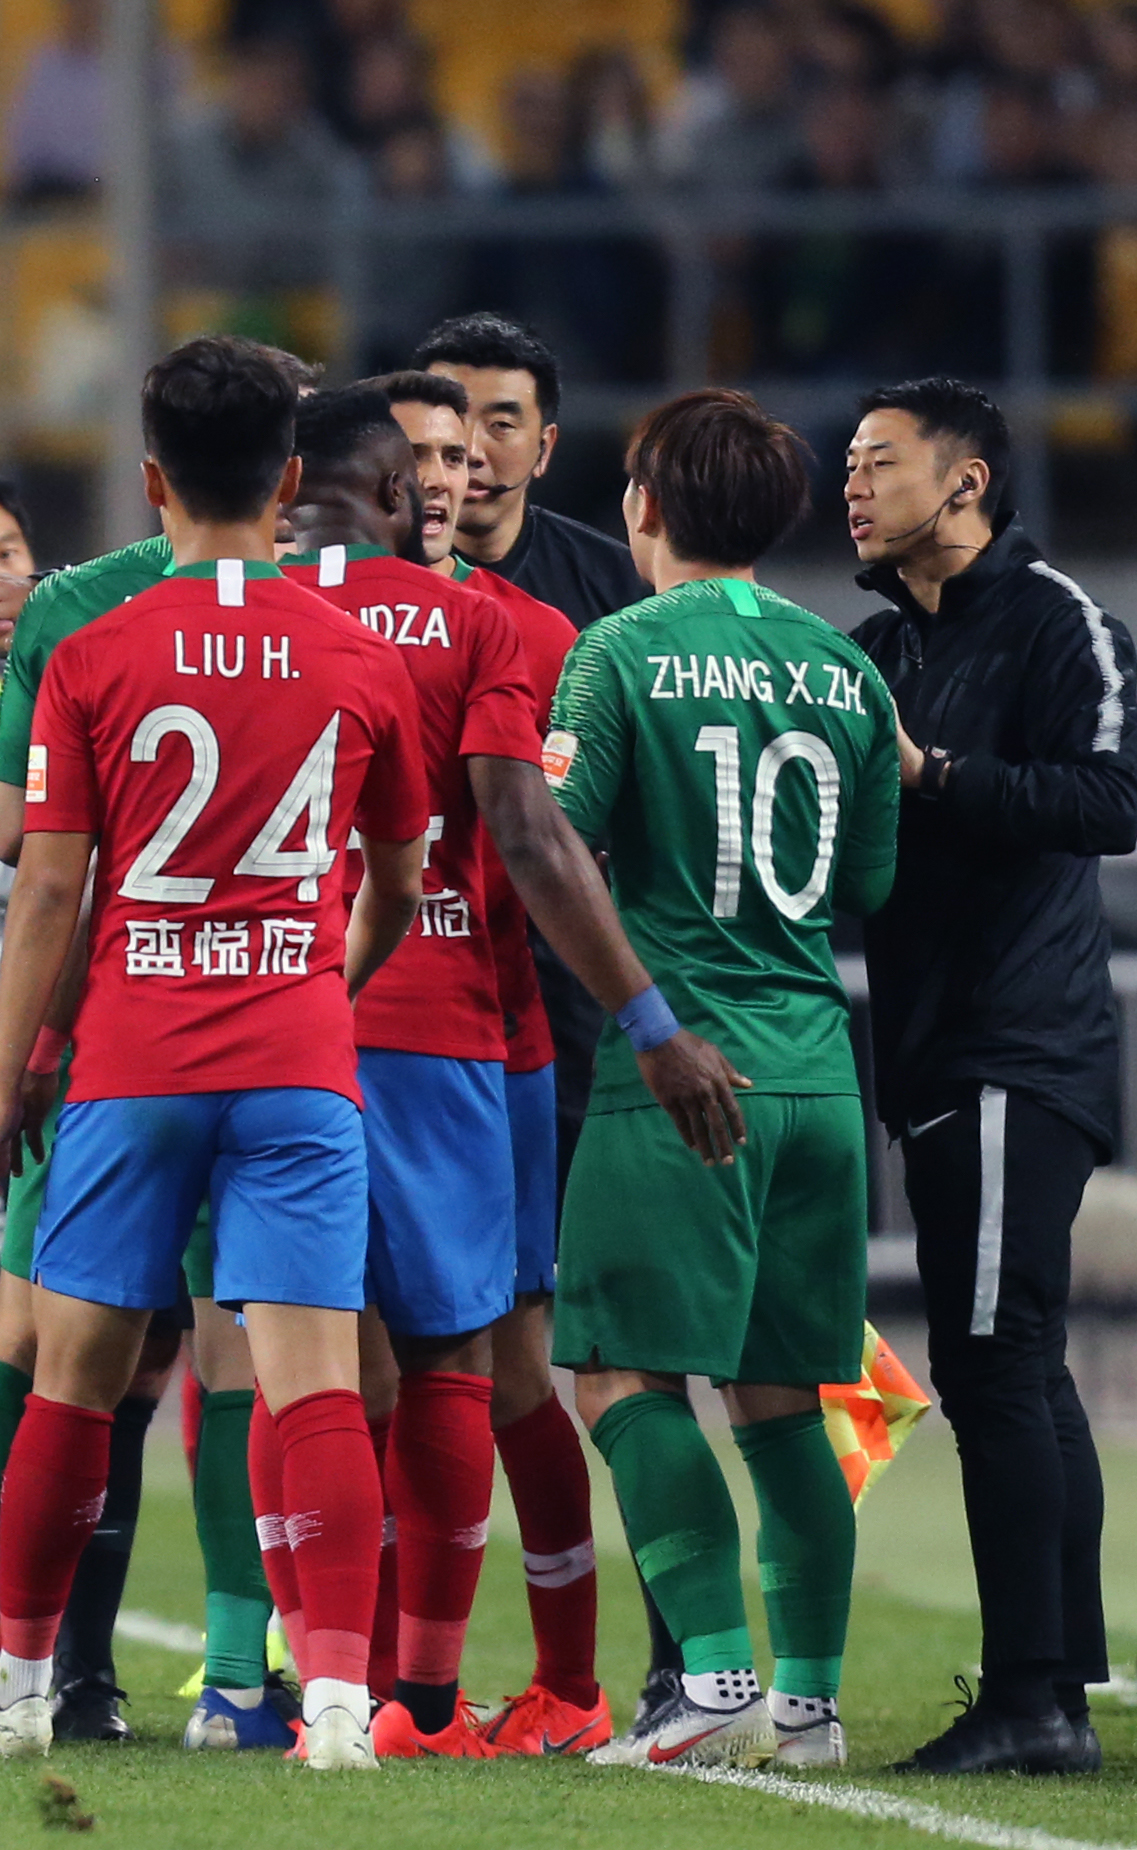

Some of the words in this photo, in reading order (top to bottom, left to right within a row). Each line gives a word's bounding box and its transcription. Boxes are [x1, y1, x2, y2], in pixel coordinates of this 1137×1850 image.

[174, 629, 246, 678] LIU
[262, 635, 301, 679] H.
[647, 654, 775, 704] ZHANG
[118, 704, 342, 904] 24
[694, 725, 841, 921] 10
[124, 918, 317, 977] 盛悦府
